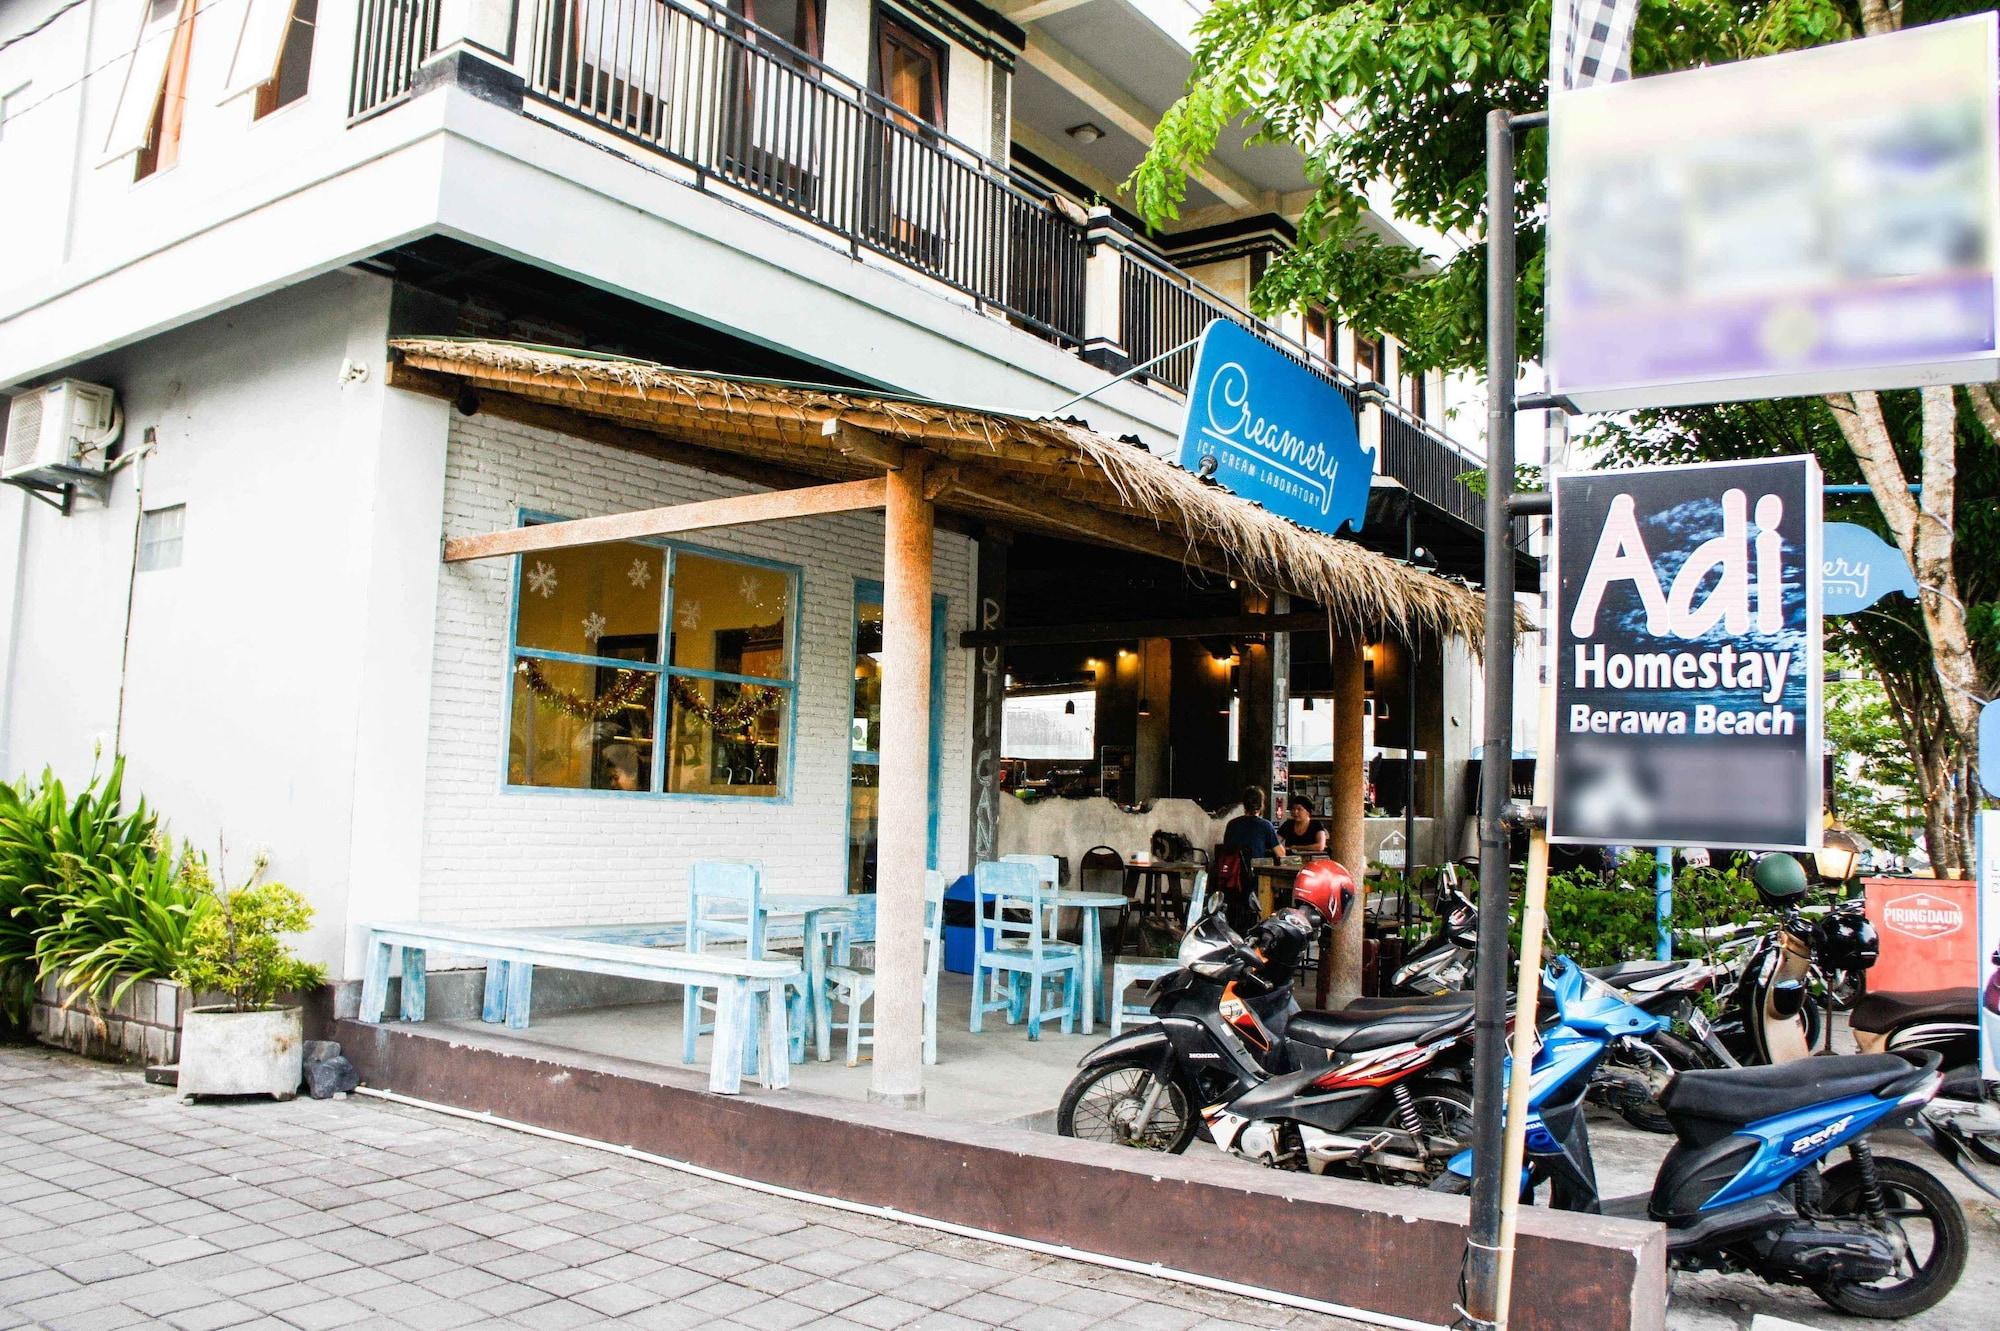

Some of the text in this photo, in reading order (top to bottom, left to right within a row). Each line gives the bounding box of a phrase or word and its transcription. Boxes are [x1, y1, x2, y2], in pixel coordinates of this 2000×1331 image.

[1206, 361, 1339, 515] Creamery
[1196, 438, 1320, 507] ICE CREAM LABORATORY
[1570, 488, 1785, 640] Adi
[1823, 557, 1870, 598] ery
[1824, 585, 1851, 595] ORY
[1574, 642, 1791, 704] Homestay
[1569, 704, 1796, 736] Berawa Beach
[975, 749, 993, 862] CAN
[1884, 908, 1962, 925] PIRINGDAUN
